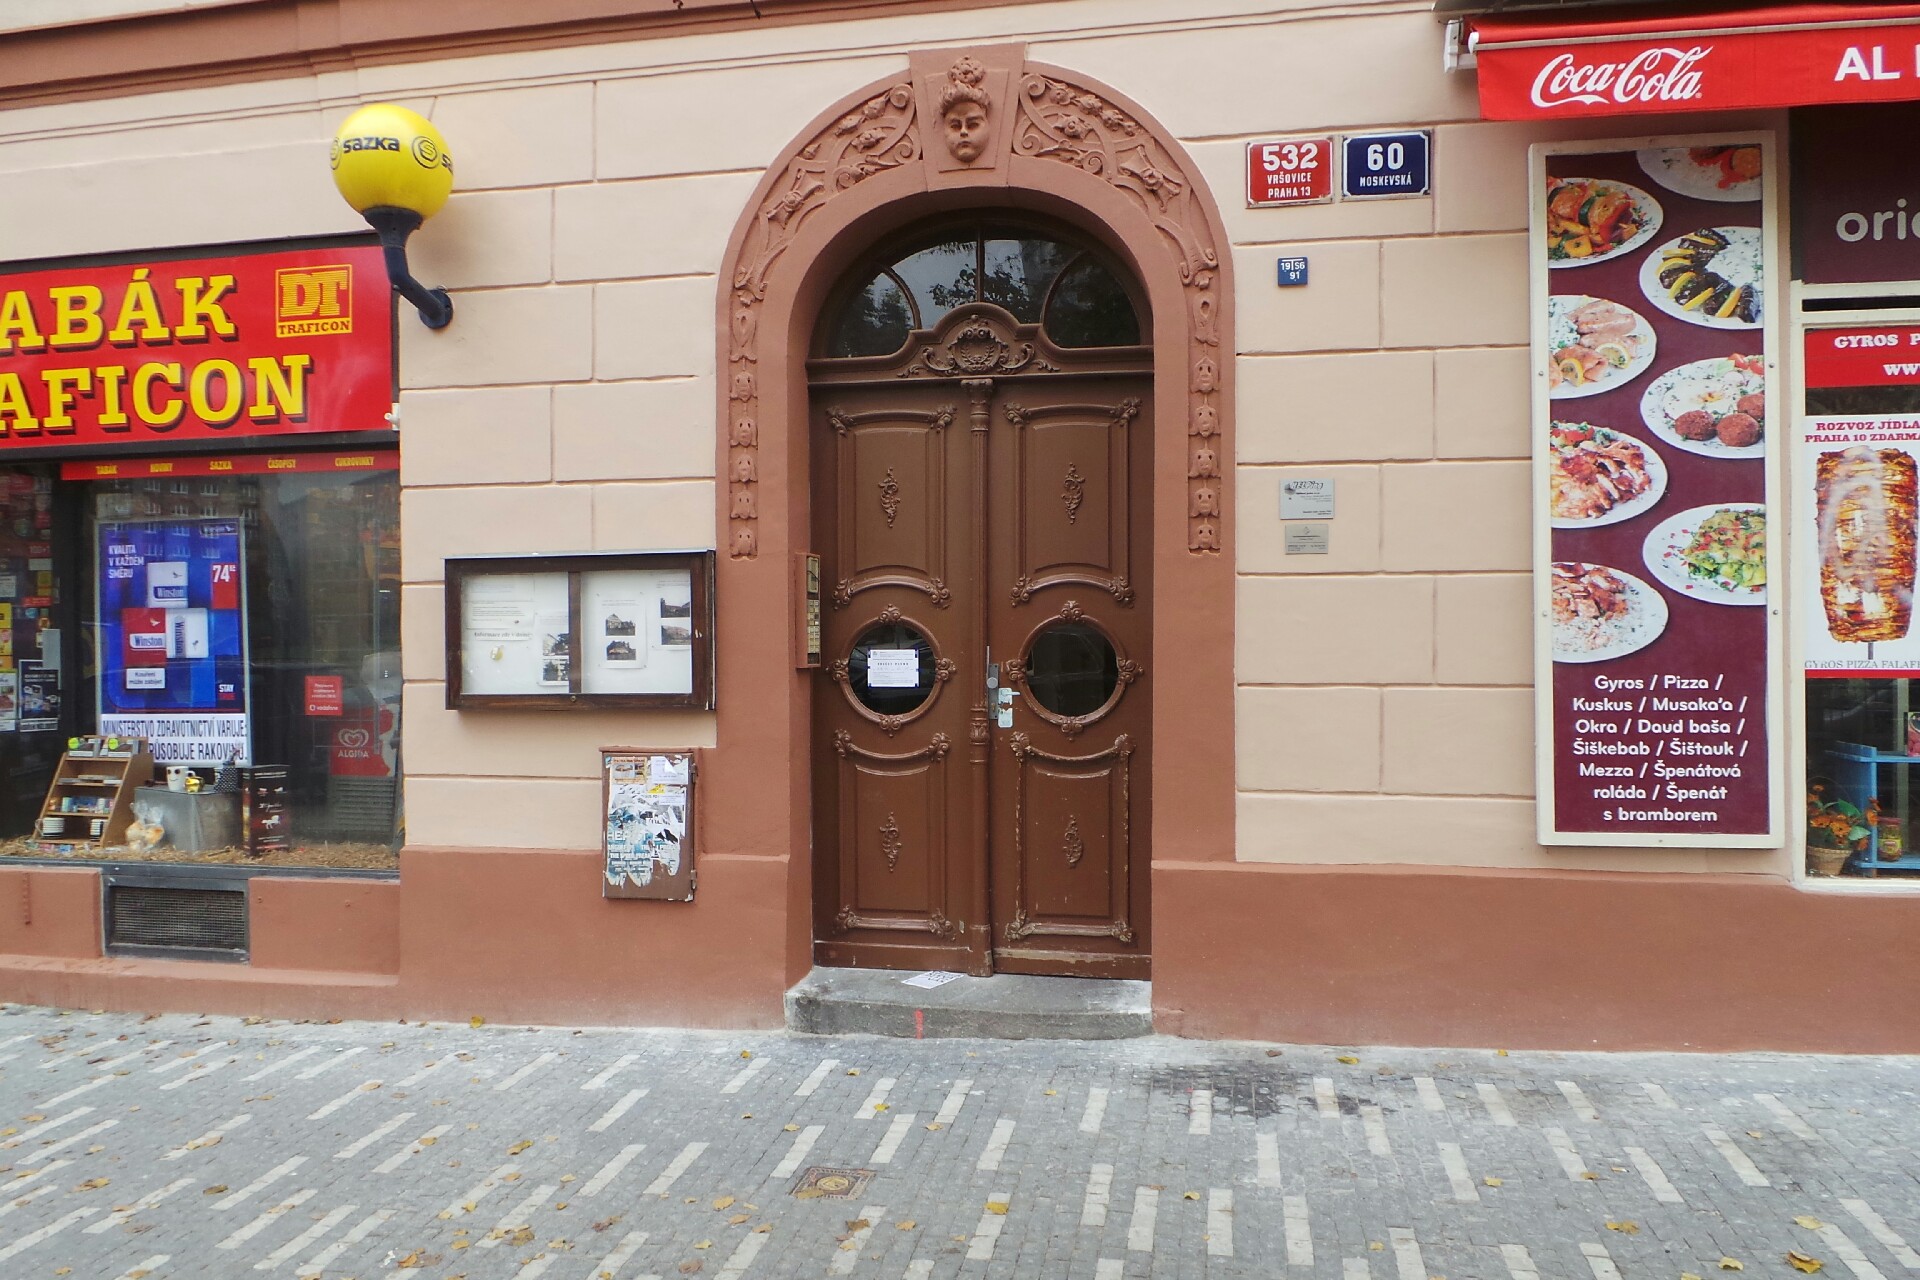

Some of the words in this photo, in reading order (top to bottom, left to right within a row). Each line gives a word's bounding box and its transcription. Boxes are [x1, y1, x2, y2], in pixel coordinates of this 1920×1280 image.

[1834, 46, 1900, 81] AL
[1531, 46, 1714, 107] Coca-Cola
[343, 137, 400, 153] sazka
[1262, 142, 1318, 171] 532
[1367, 142, 1404, 170] 60
[1267, 171, 1312, 184] VRŠOVICE
[1360, 172, 1412, 187] MOSKEVSKÁ
[1268, 187, 1298, 198] PRAHA
[1300, 186, 1311, 196] 13
[1836, 198, 1920, 242] ori
[1290, 271, 1300, 280] 91
[0, 268, 236, 350] ABÁK
[278, 320, 351, 334] TRAFICON
[1834, 334, 1898, 348] GYROS
[1883, 363, 1920, 376] WW
[0, 354, 310, 431] AFICON
[1816, 422, 1875, 431] ROZVOZ
[1805, 434, 1850, 442] PRAHA
[1870, 433, 1920, 441] ZDARM
[209, 460, 233, 470] SAZKA
[213, 565, 230, 583] 74
[157, 587, 184, 599] Winston
[134, 635, 163, 646] Winston
[1805, 660, 1843, 668] GYROS
[1847, 660, 1878, 668] PIZZA
[1594, 675, 1644, 692] Gyros
[1664, 675, 1709, 689] Pizza
[1573, 698, 1633, 711] Kuskus
[1653, 698, 1733, 711] Musaka'a
[103, 720, 154, 737] MINISTERSTVO
[157, 717, 214, 737] ZDRAVOTNICTVÍ
[217, 720, 247, 737] VARUJE:
[1575, 720, 1617, 733] Okra
[1638, 720, 1683, 733] Daud
[1689, 720, 1731, 733] baša
[1573, 738, 1650, 755] Šiškebab
[1670, 738, 1733, 755] Šištauk
[338, 750, 369, 758] ALGIDA
[1579, 763, 1634, 777] Mezza
[1654, 760, 1741, 779] Špenátová
[1594, 785, 1646, 798] roláda
[1666, 782, 1728, 802] Špenát
[1603, 811, 1612, 821] s
[1619, 808, 1717, 821] bramborem
